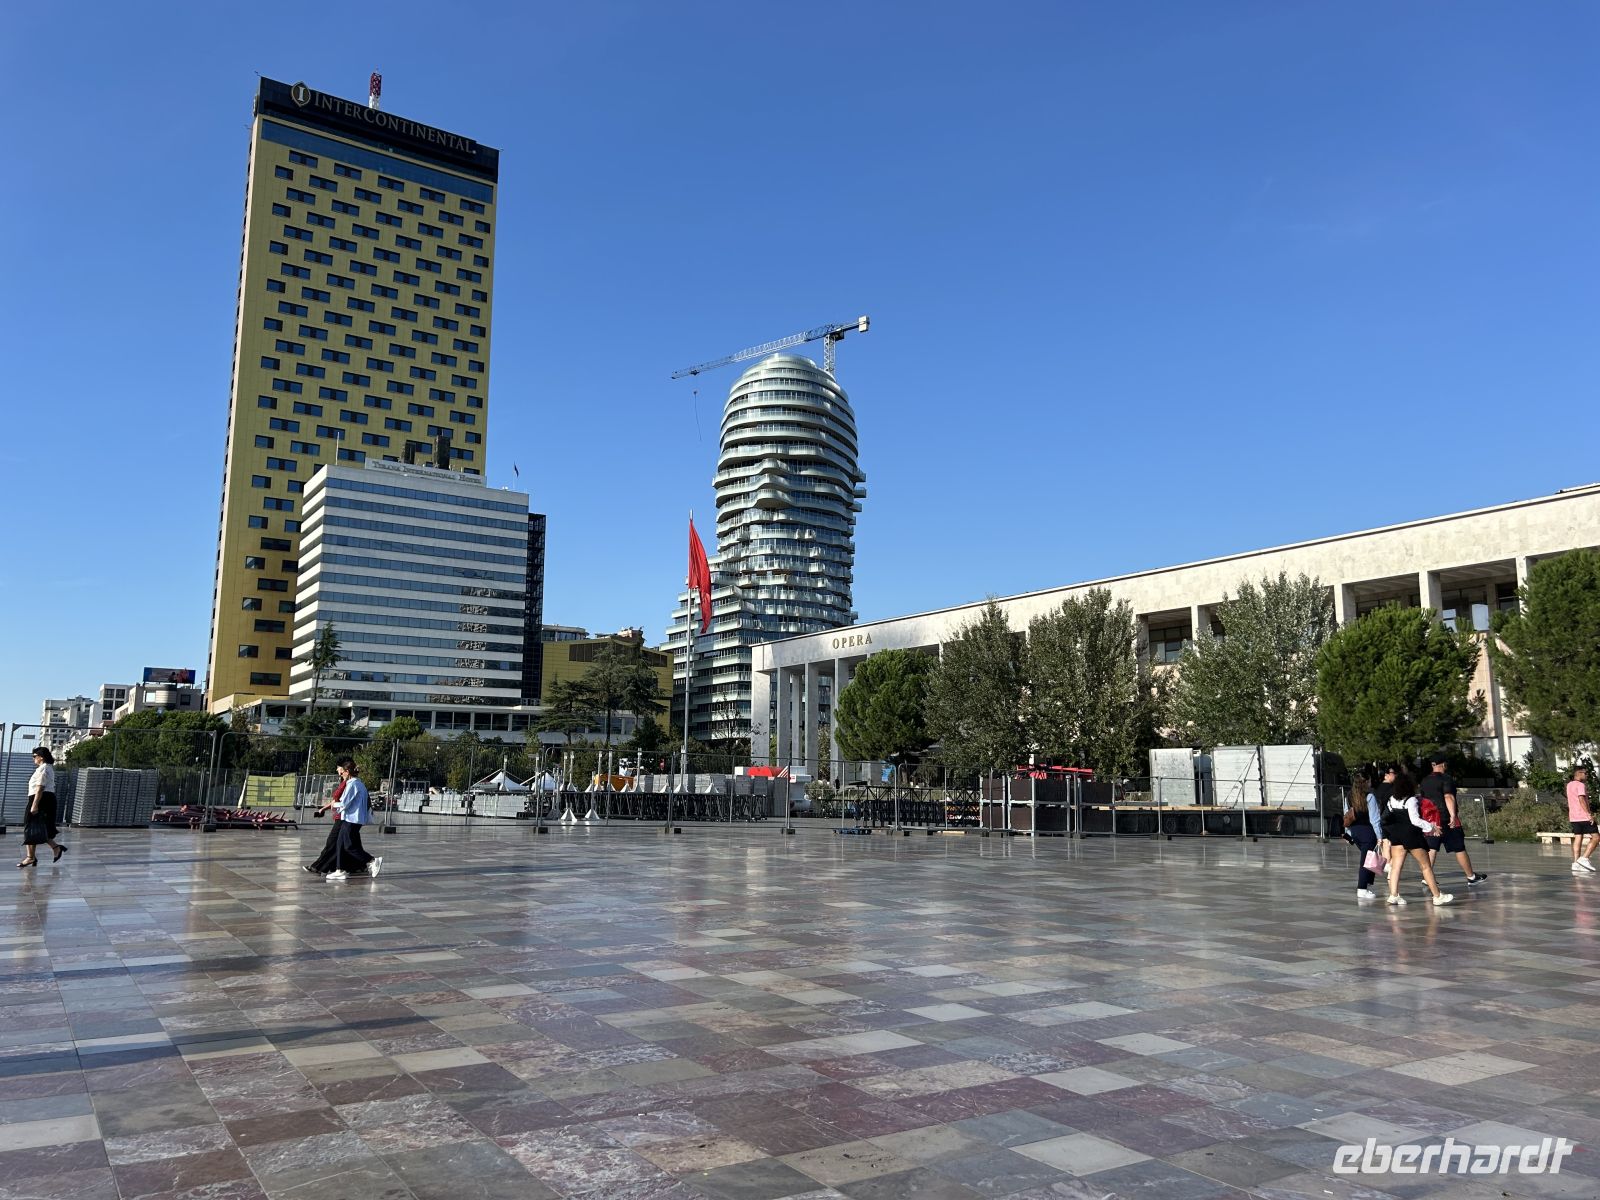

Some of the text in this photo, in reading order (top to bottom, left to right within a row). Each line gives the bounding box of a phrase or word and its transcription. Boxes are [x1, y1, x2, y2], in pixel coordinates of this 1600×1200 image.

[403, 465, 456, 480] INTERNATIONAL
[459, 474, 482, 484] HOTEL
[832, 632, 872, 649] OPERA
